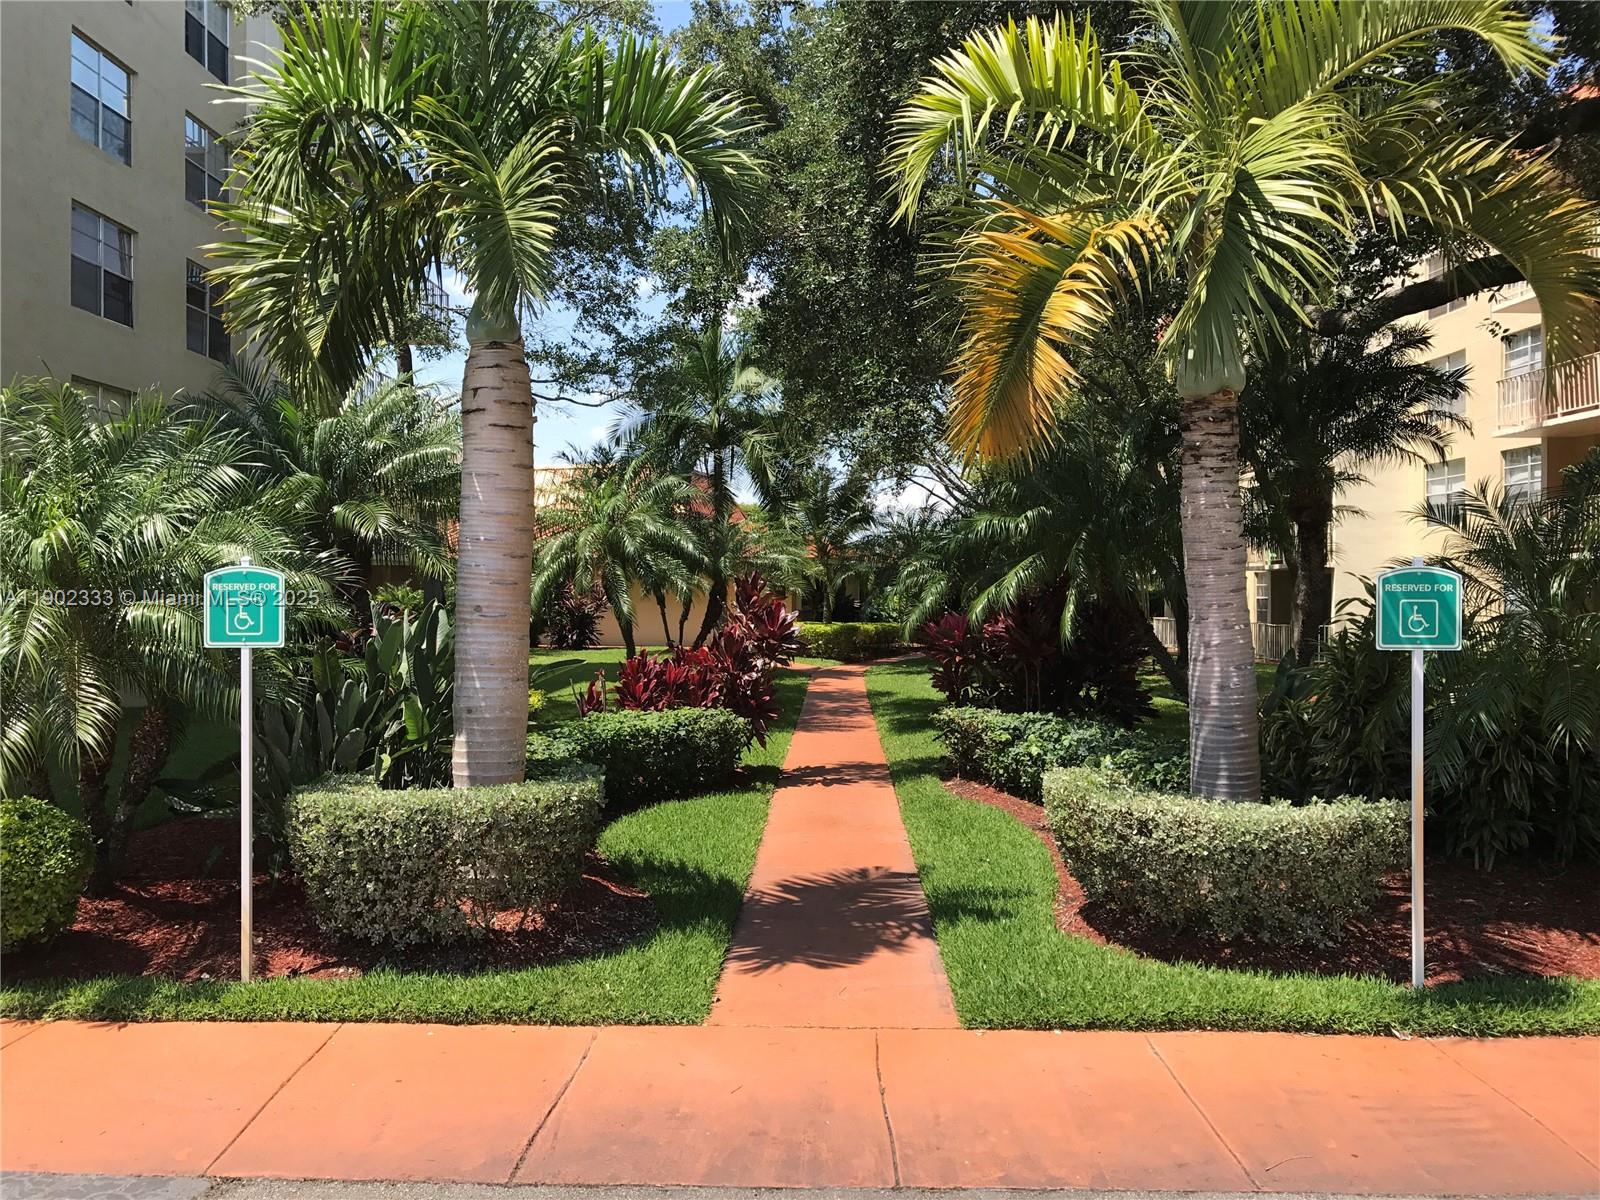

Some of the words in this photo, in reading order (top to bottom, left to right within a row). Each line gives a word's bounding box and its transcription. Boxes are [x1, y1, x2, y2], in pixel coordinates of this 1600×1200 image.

[212, 582, 256, 591] RESERVED
[258, 582, 277, 591] FOR
[1385, 583, 1431, 592] RESERVED
[1434, 583, 1454, 592] FOR
